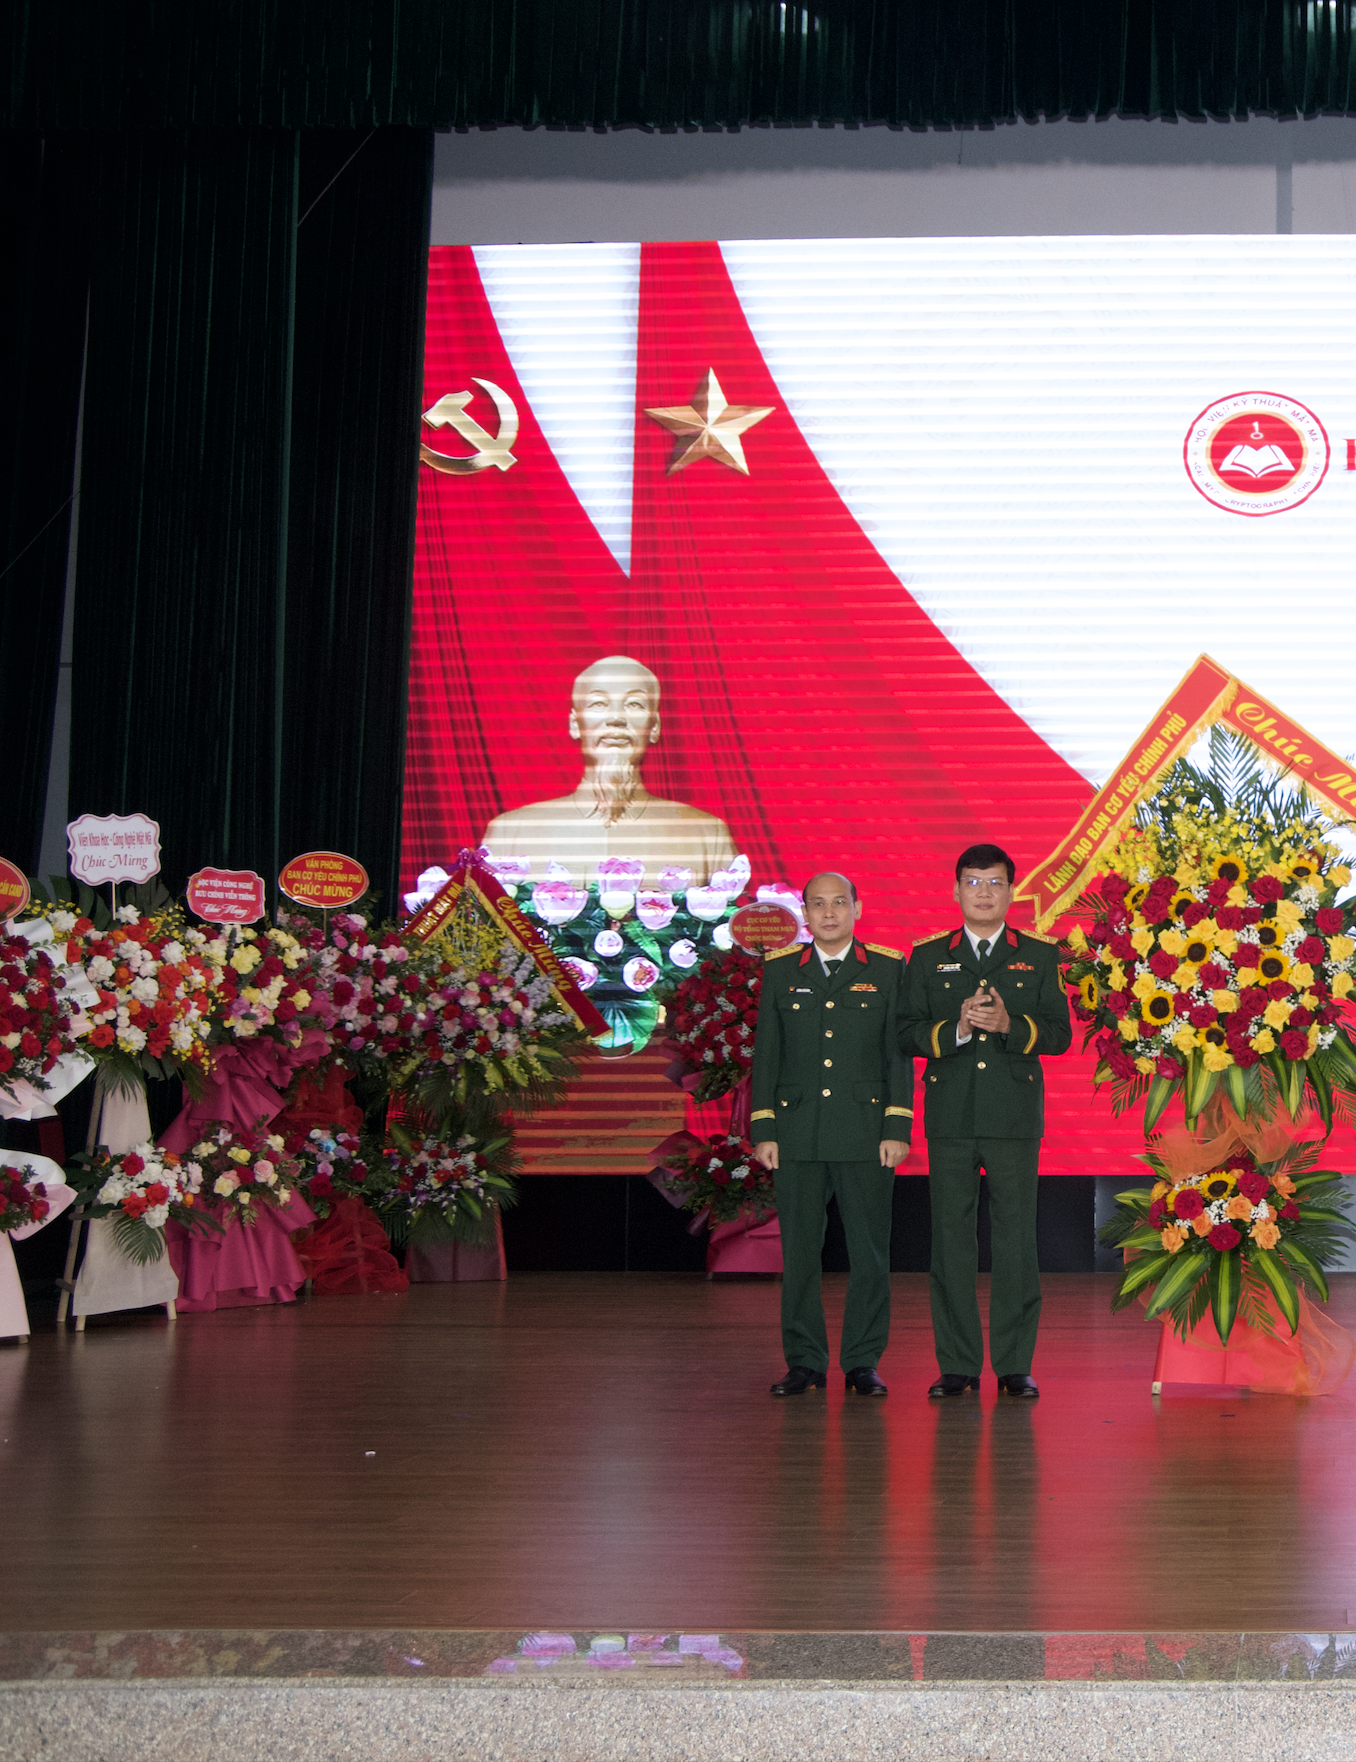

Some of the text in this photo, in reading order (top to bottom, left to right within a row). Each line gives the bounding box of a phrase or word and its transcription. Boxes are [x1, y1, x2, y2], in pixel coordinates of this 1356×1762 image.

[1235, 702, 1314, 769] Chúc
[1043, 710, 1187, 893] LÃNH ĐẠO BAN CƠ YẾU CHÍNH PHỦ
[81, 854, 148, 872] Chúc Mừng
[305, 858, 343, 870] VĂN PHÒNG
[287, 870, 362, 883] BAN CƠ YẾU CHÍNH PHỦ
[292, 882, 353, 898] CHÚC MỪNG
[497, 896, 572, 992] Chúc Mừng
